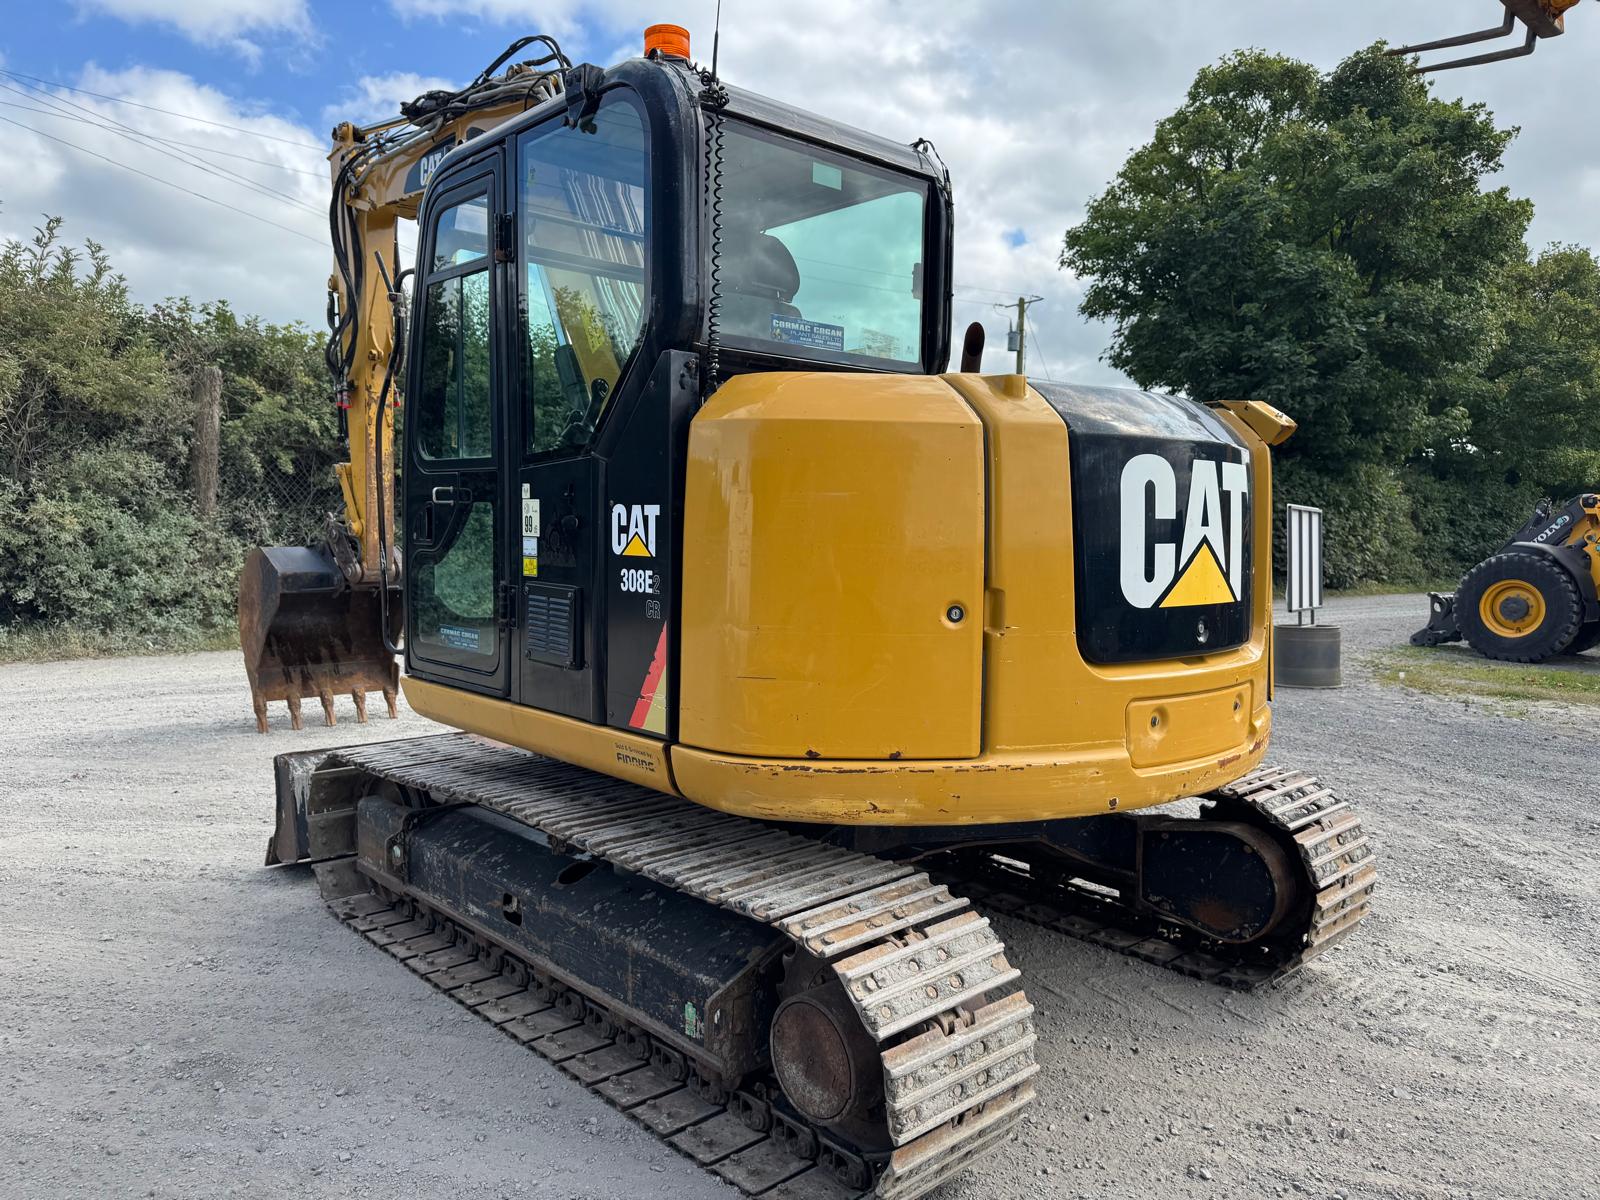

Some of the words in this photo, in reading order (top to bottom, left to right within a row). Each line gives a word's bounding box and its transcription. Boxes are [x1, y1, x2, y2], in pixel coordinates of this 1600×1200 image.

[772, 319, 811, 333] CORMAC
[524, 515, 533, 533] 99
[612, 503, 660, 557] CAT
[1120, 453, 1249, 608] CAT
[646, 600, 660, 619] CR
